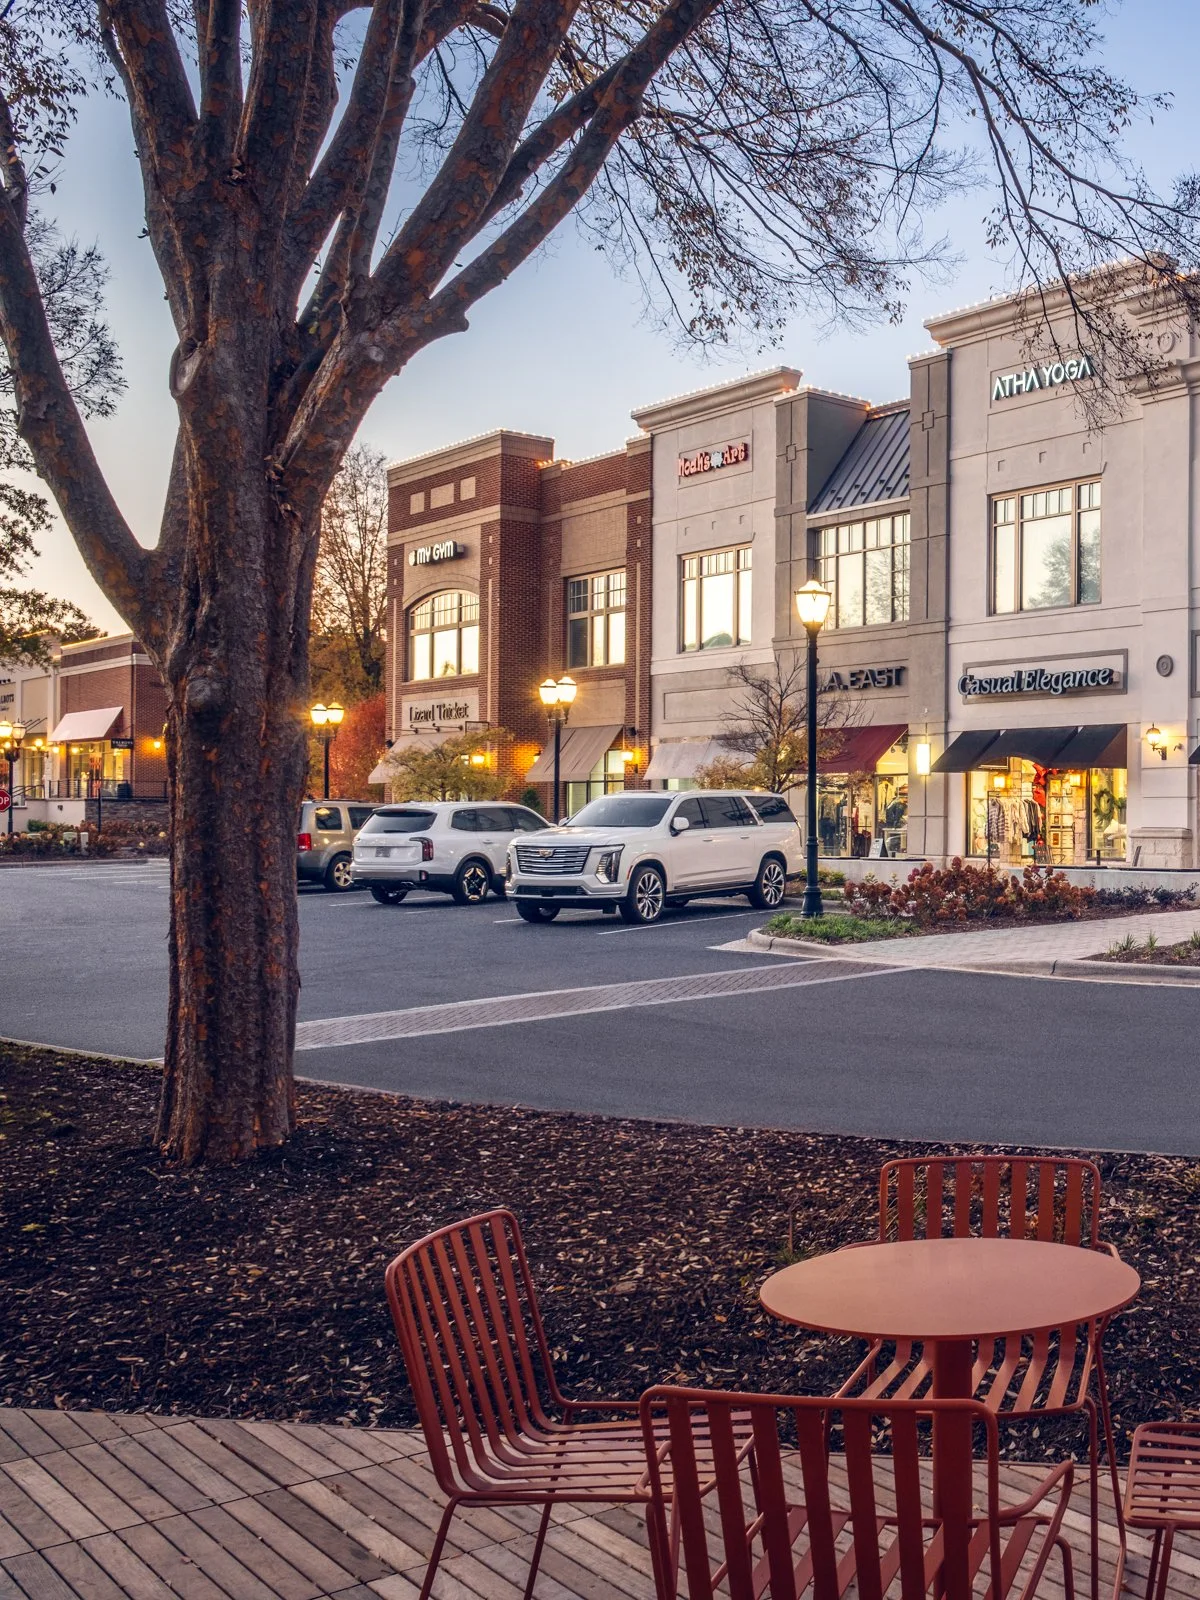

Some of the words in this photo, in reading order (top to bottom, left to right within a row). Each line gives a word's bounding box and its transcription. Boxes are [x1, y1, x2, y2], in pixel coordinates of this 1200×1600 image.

[992, 367, 1041, 401] ATHA
[1042, 356, 1091, 387] YOGA
[958, 670, 1020, 695] Casual
[1022, 667, 1111, 694] Elegance
[409, 704, 435, 722] Lizard
[436, 701, 470, 721] Thicket
